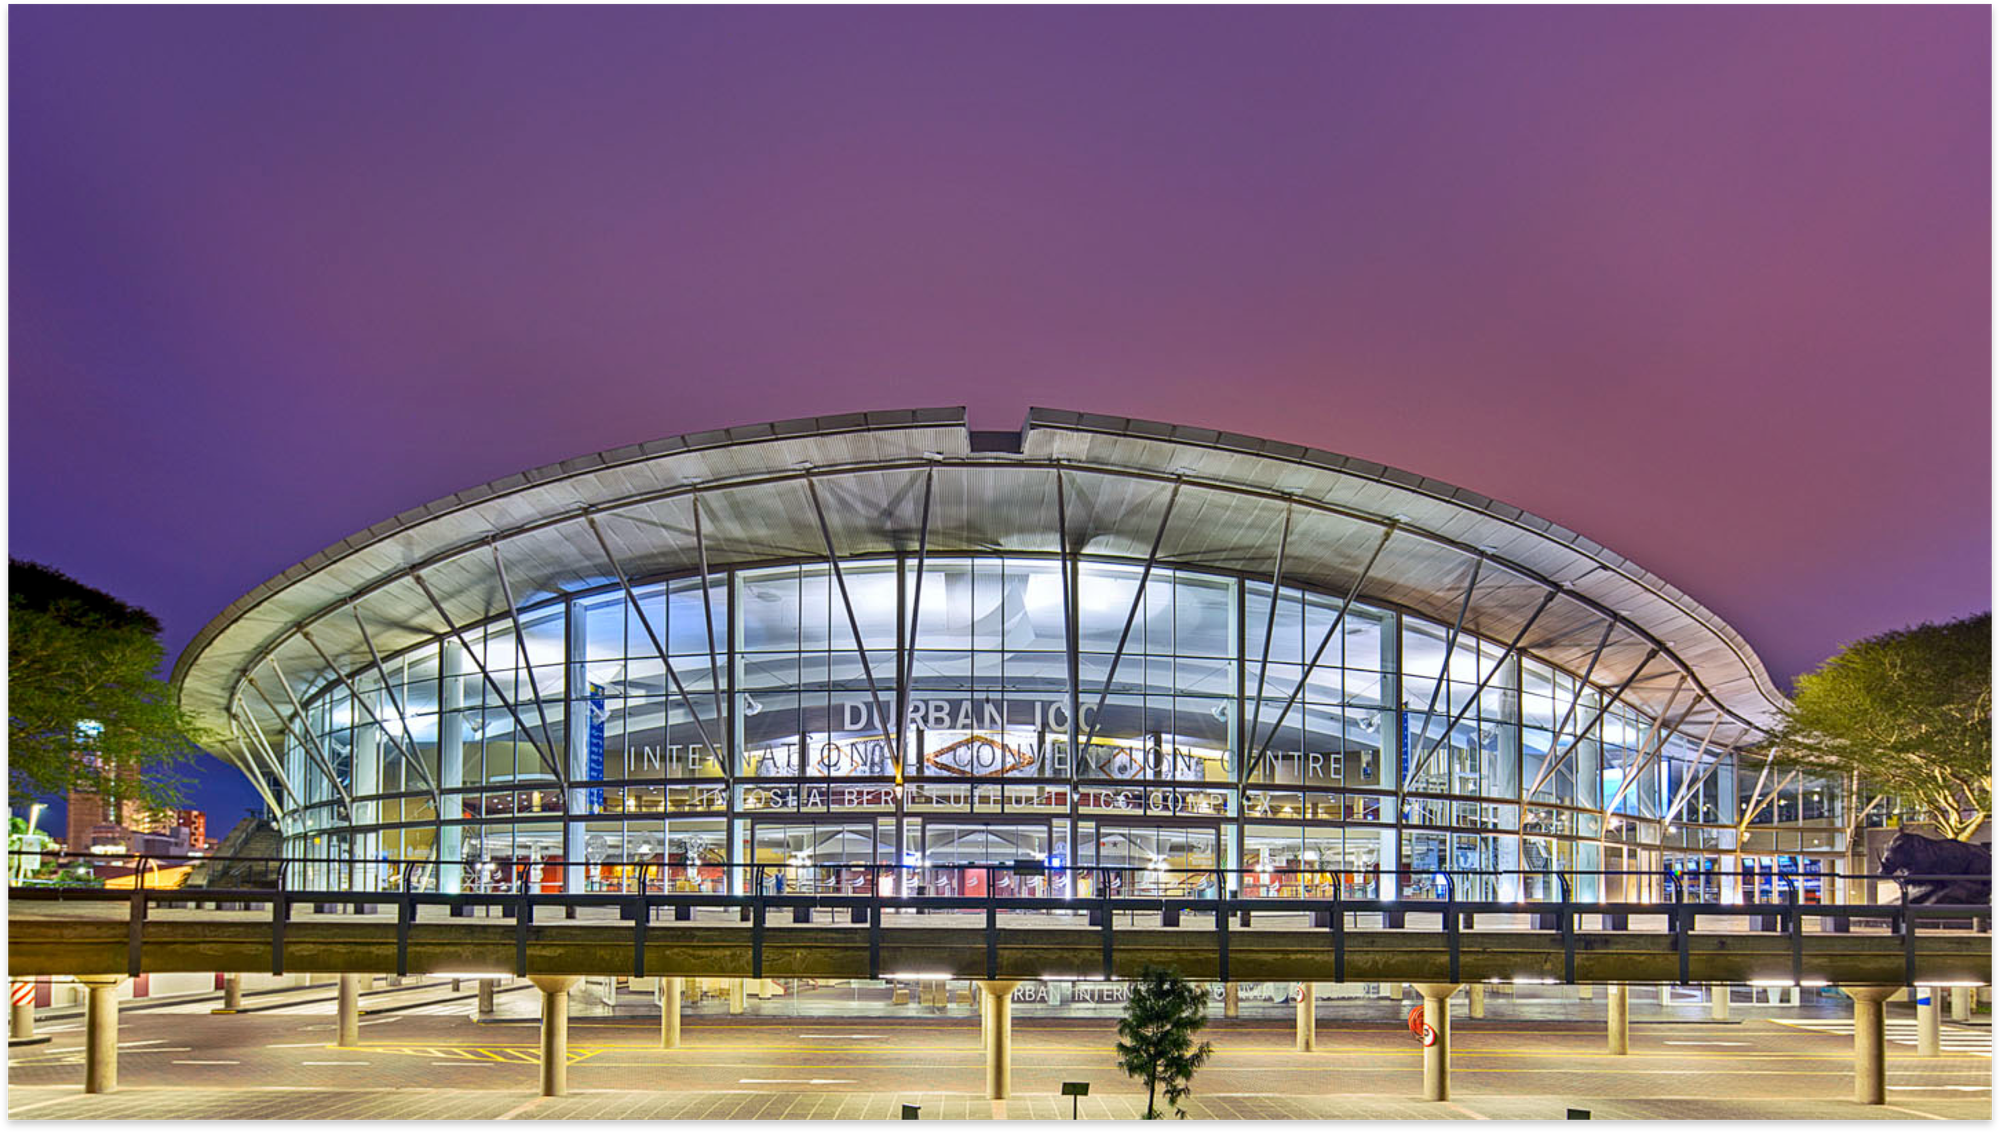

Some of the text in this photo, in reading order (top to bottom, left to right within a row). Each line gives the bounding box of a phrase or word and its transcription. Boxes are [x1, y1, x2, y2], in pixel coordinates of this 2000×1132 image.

[844, 700, 1102, 732] DURBAN ICC
[703, 788, 793, 808] INOSI
[807, 788, 914, 808] ABERT
[1090, 791, 1133, 811] ICC
[1149, 791, 1272, 815] COMPEX
